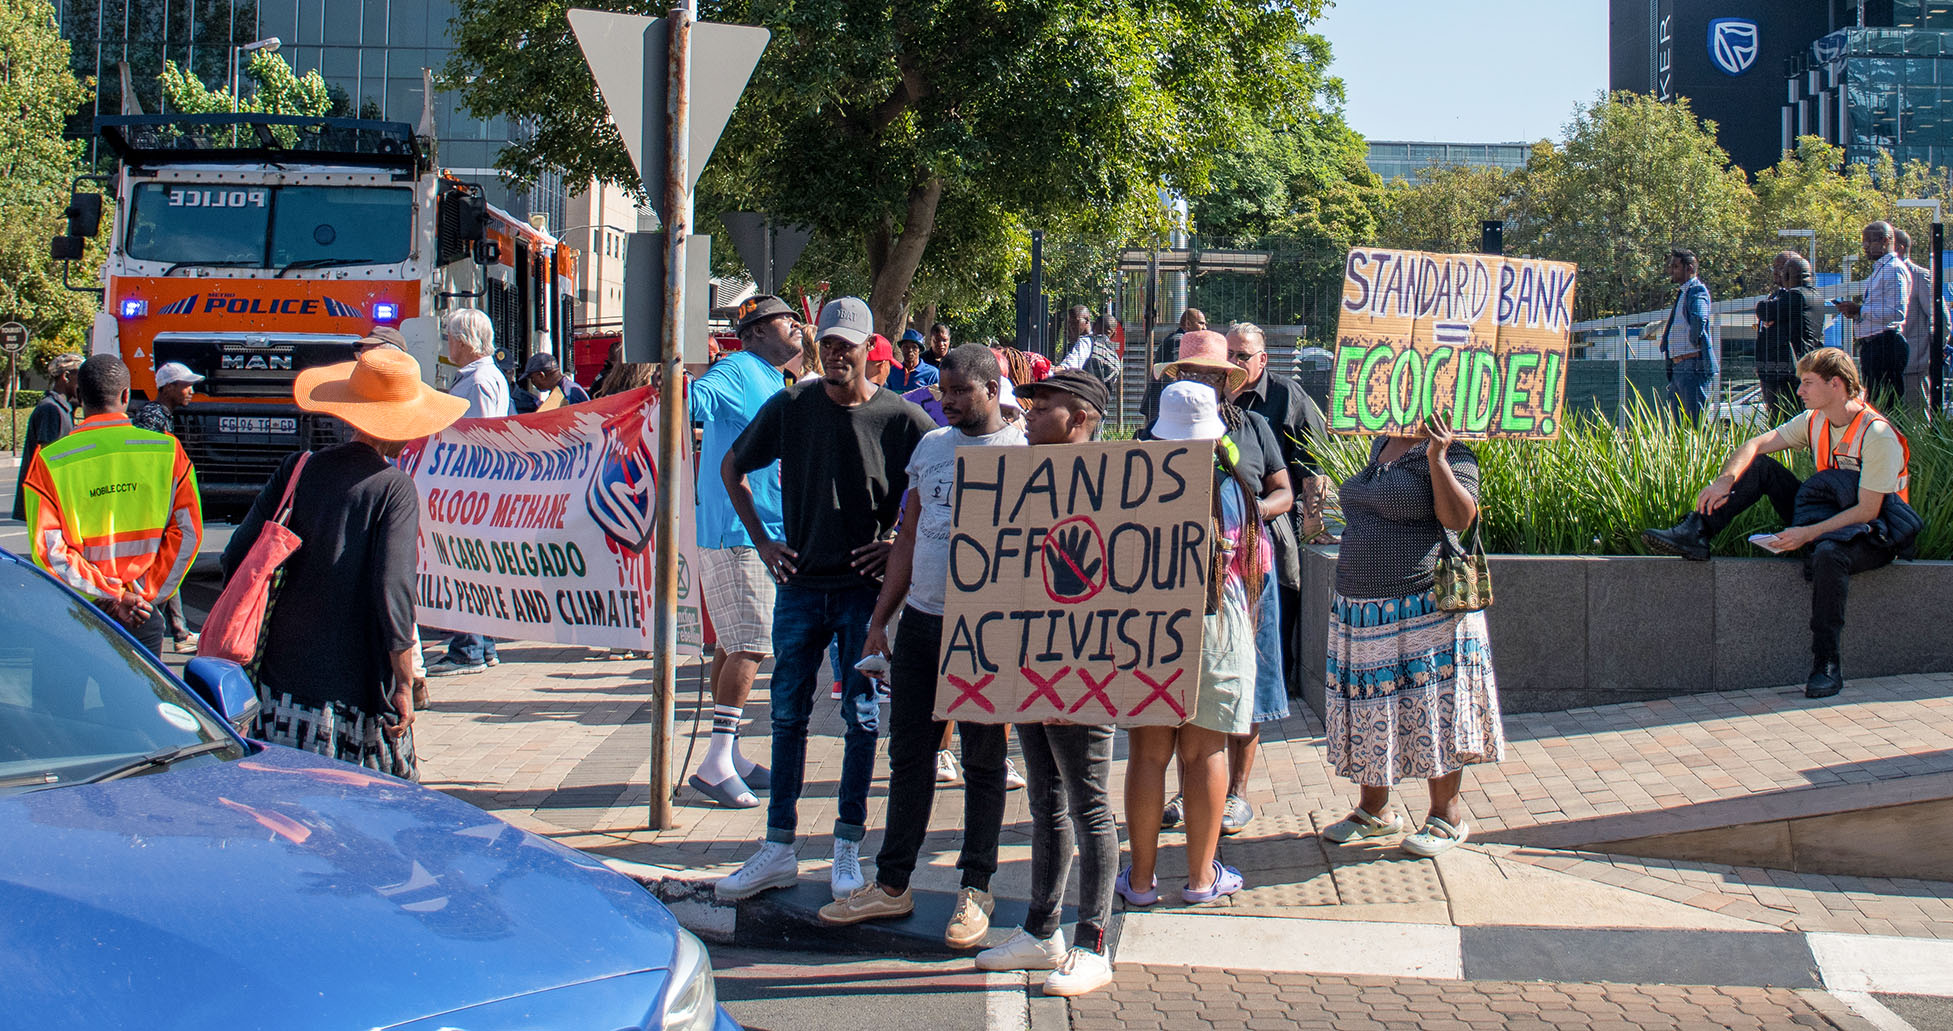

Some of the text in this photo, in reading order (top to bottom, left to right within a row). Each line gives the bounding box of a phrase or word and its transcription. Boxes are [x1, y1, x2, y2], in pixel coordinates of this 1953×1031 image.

[203, 298, 320, 314] POLICE
[1344, 251, 1575, 331] STANDARD BANK
[221, 354, 293, 370] MAN
[1332, 345, 1561, 435] ECOCIDE!
[428, 442, 593, 481] STANDARD BANK'S
[89, 482, 137, 497] MOBILE CCTV
[428, 488, 571, 529] BLOOD METHANE
[953, 448, 1188, 528] HANDS
[431, 532, 587, 577] IN CABO DELGADO
[950, 521, 1206, 594] OFF OUR
[453, 578, 510, 620] PEOPLE
[512, 588, 551, 623] AND
[556, 589, 642, 629] CLIMATE
[940, 608, 1192, 676] ACTIVISTS
